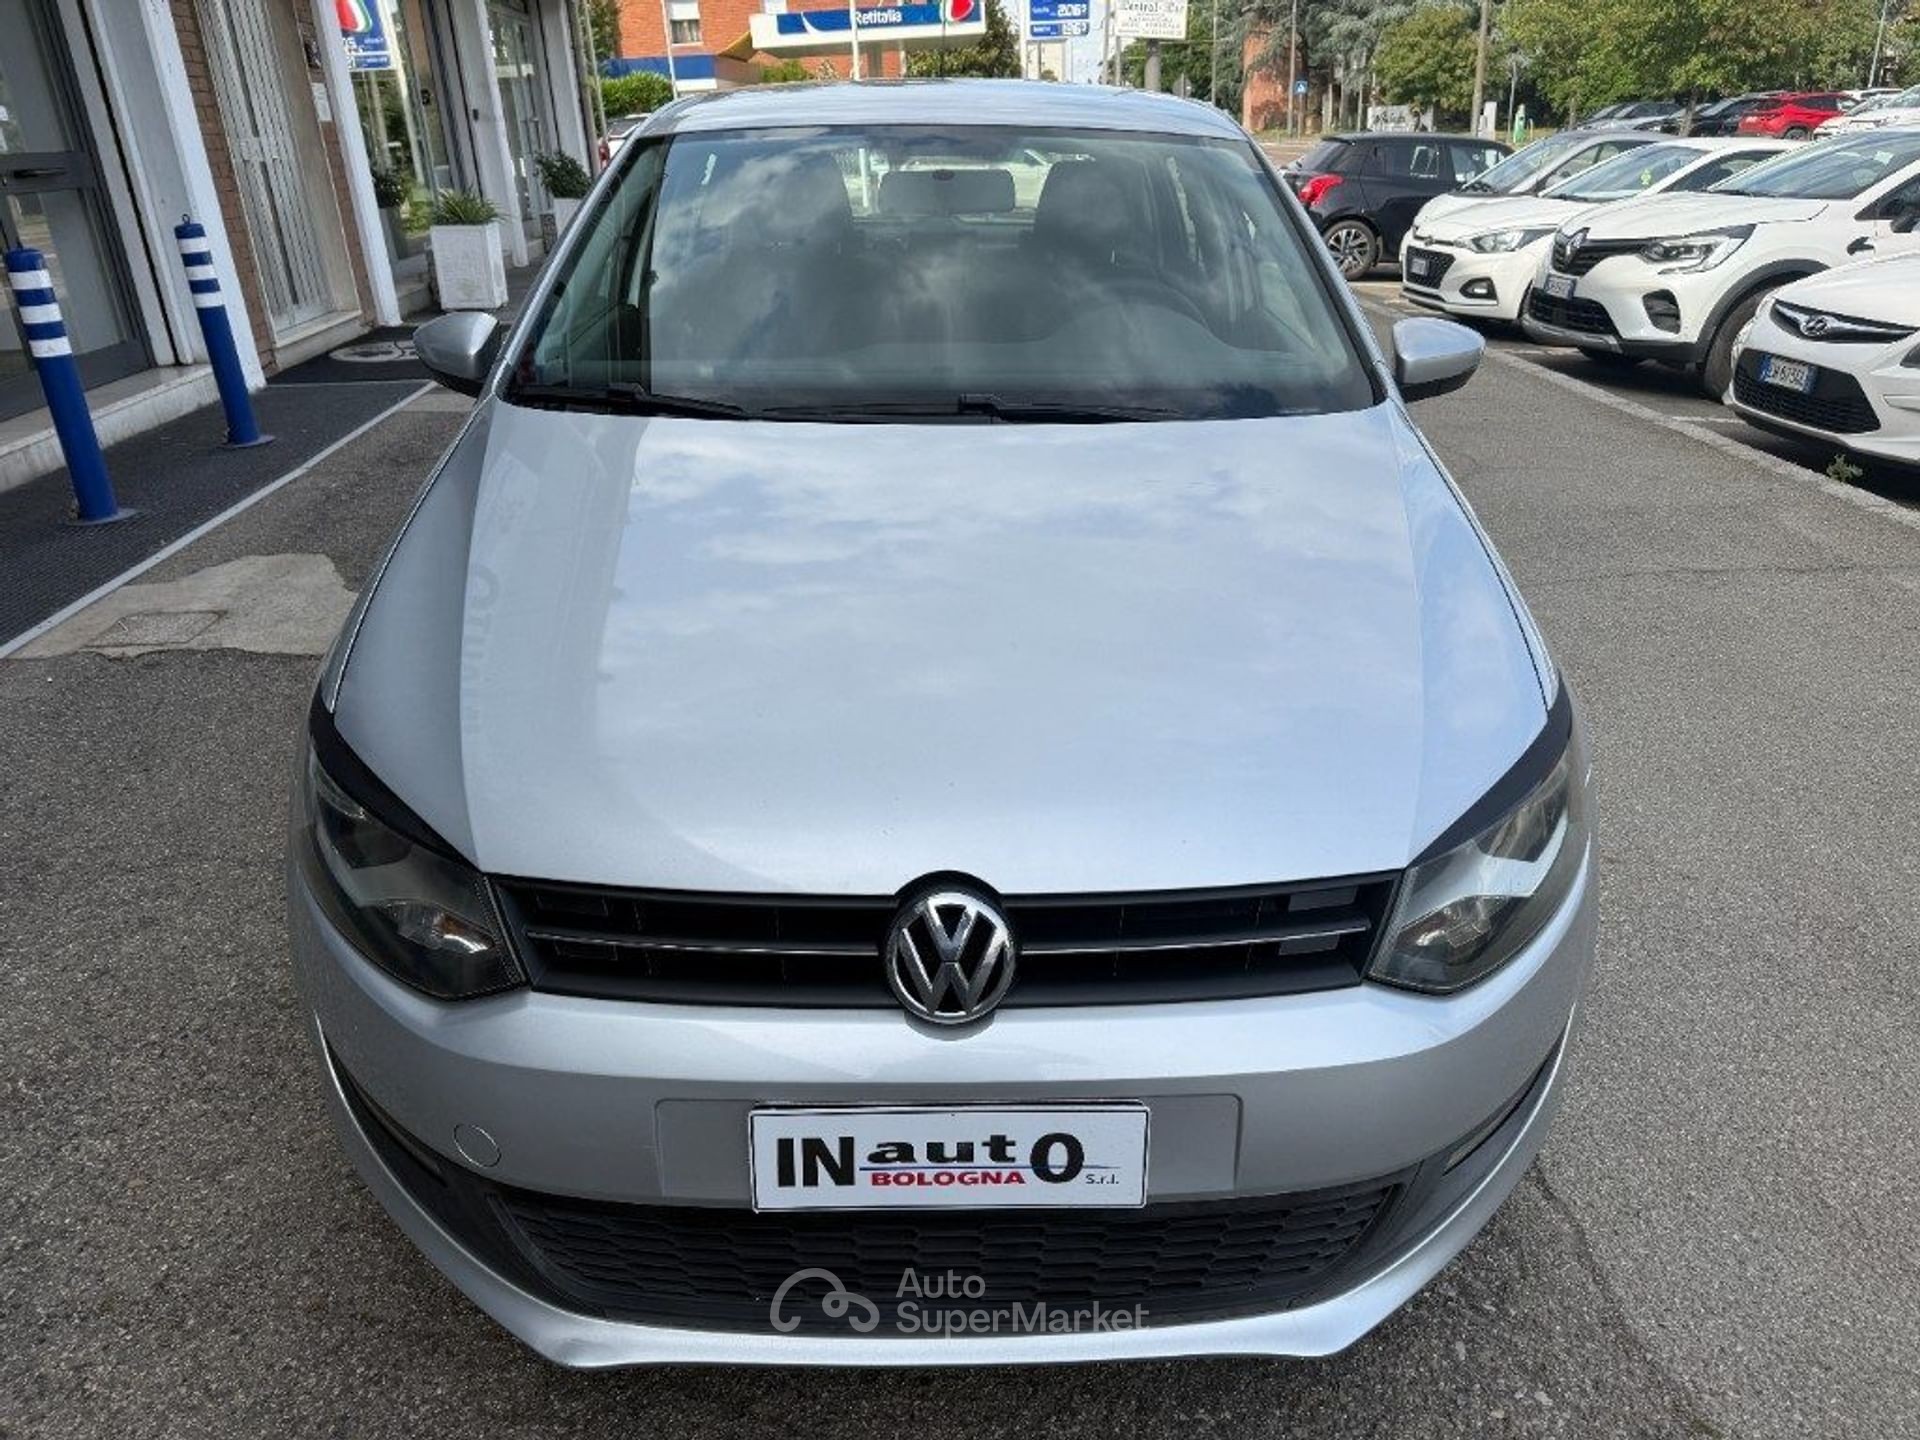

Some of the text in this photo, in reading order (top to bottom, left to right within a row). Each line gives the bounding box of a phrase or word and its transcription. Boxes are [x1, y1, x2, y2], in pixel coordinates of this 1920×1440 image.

[854, 9, 902, 25] Retitalia
[887, 891, 1016, 1024] VW
[871, 1171, 1026, 1186] BOLOGNA
[1085, 1174, 1119, 1185] S.r.l.
